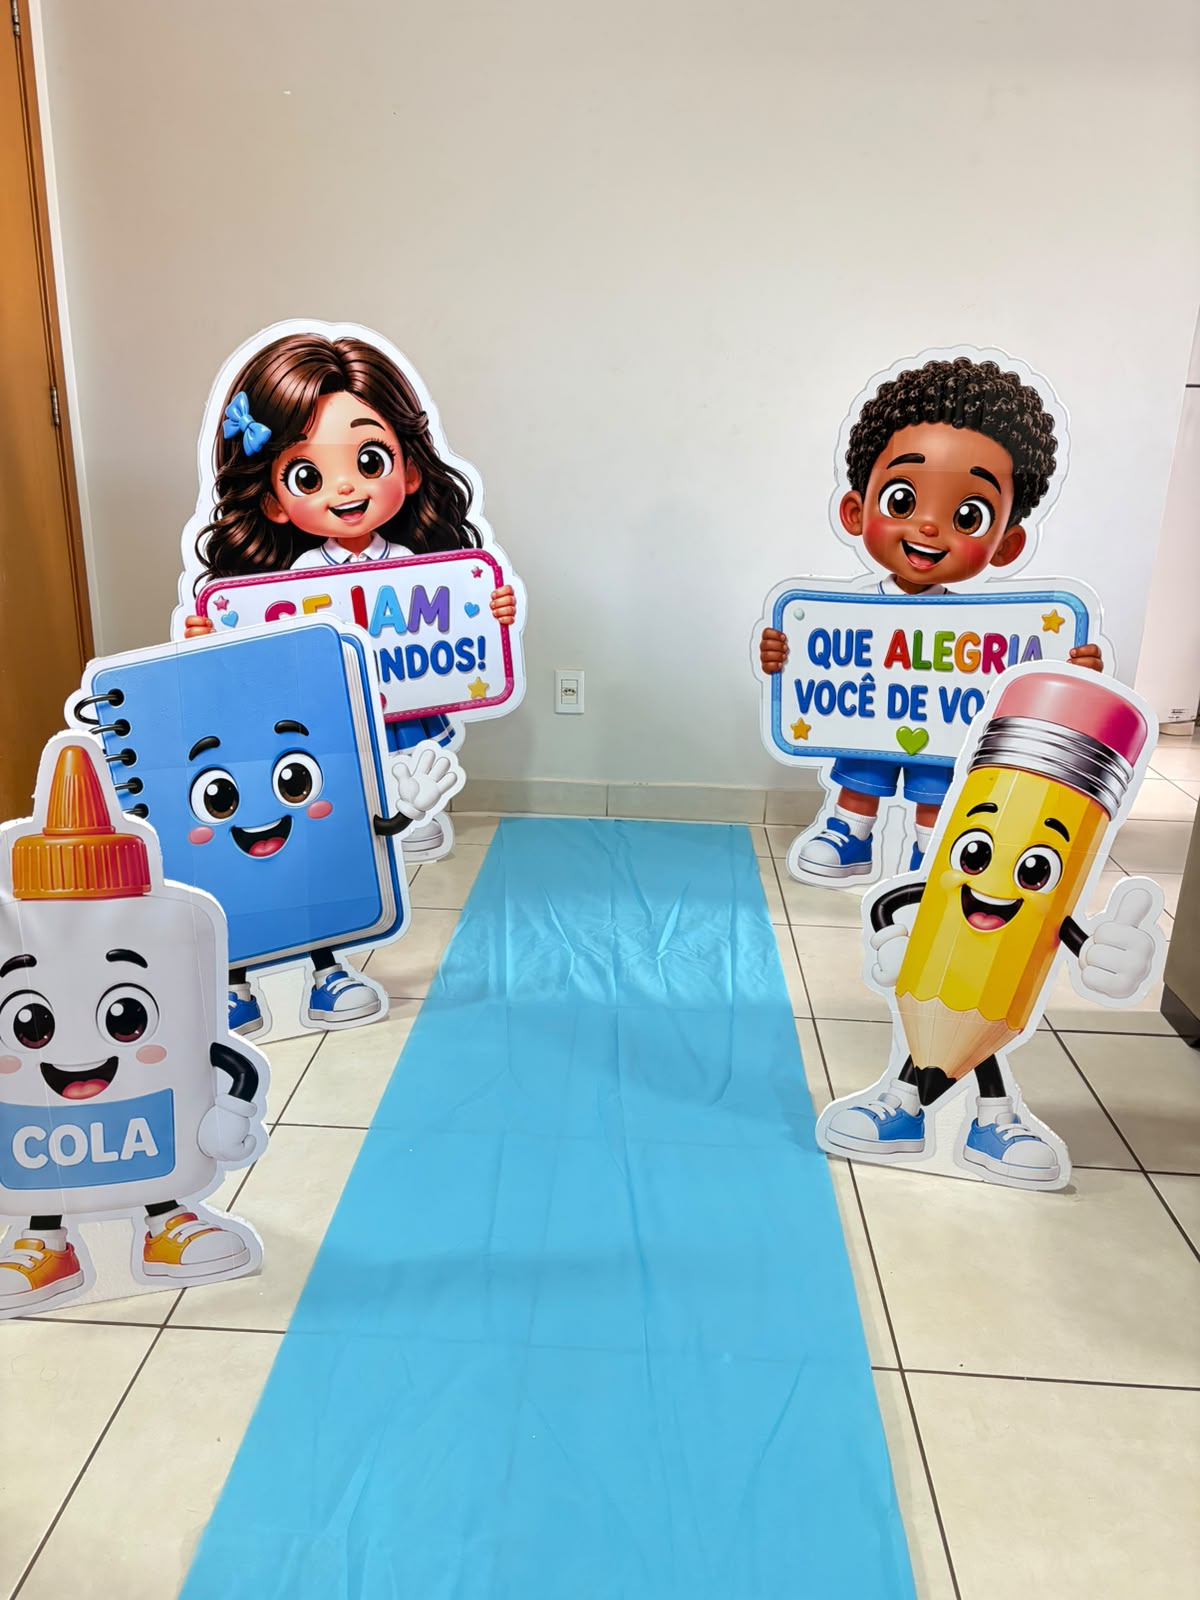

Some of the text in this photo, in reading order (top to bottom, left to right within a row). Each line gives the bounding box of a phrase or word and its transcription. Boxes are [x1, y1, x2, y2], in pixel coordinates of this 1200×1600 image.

[374, 635, 486, 683] NDOS!
[808, 628, 1043, 675] QUE ALEGRIA
[795, 672, 990, 726] VOCÊ DE VO
[12, 1117, 159, 1170] COLA
